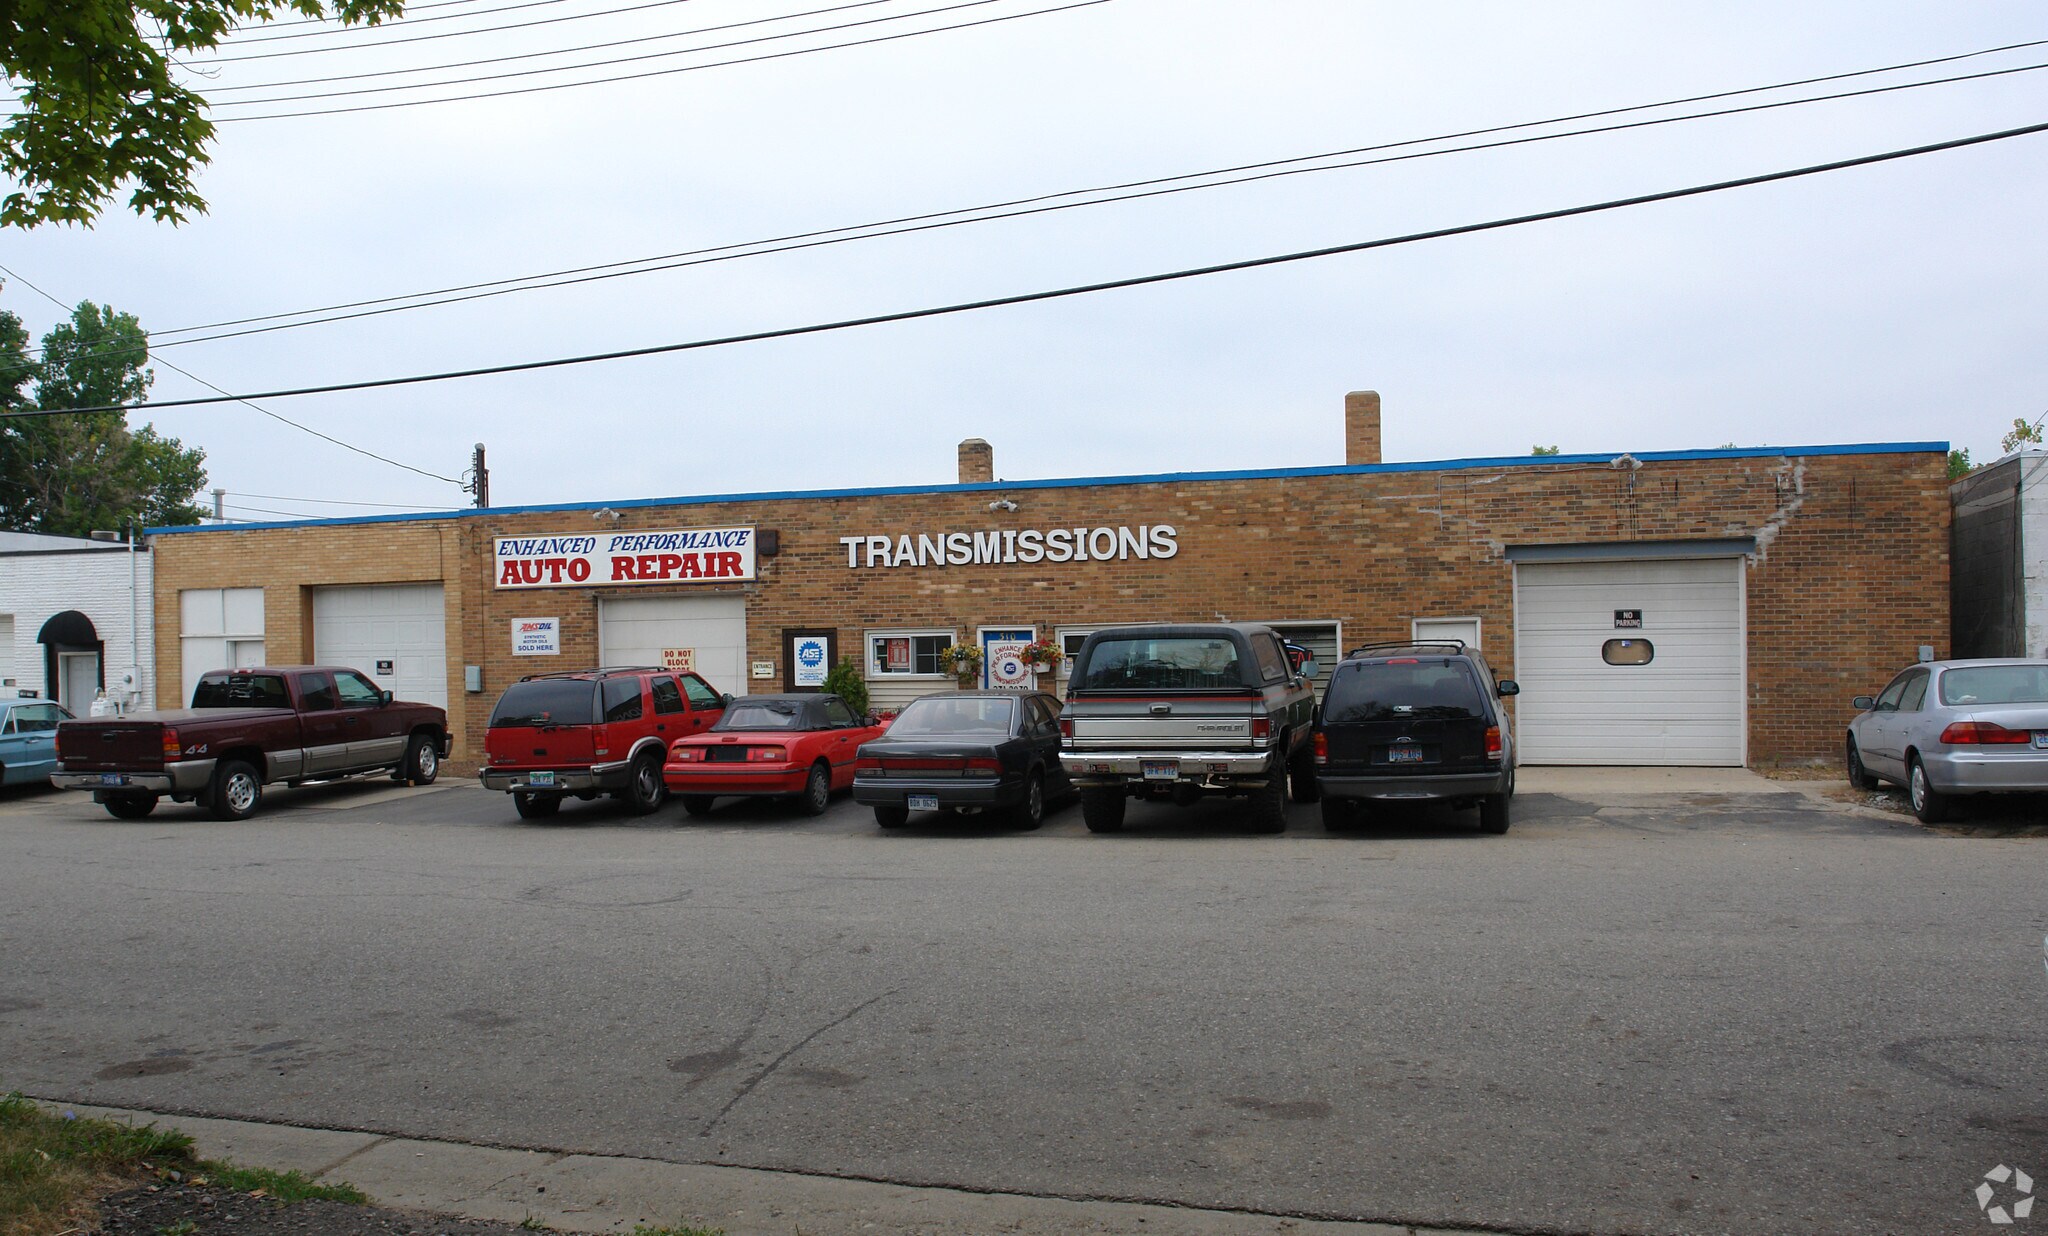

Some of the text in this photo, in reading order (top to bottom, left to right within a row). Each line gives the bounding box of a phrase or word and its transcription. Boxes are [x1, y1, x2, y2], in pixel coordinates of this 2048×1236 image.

[497, 530, 751, 556] ENHANCED PERFORMANCE
[839, 525, 1178, 568] TRANSMISSIONS
[500, 552, 743, 584] AUTO REPAIR
[1623, 611, 1633, 619] NO
[520, 622, 553, 632] AMSOIL
[1616, 619, 1641, 628] PARKING
[664, 650, 692, 658] DO NOT
[801, 648, 820, 658] ASE
[994, 645, 1023, 655] ENHANCE
[667, 658, 690, 666] BLOCK
